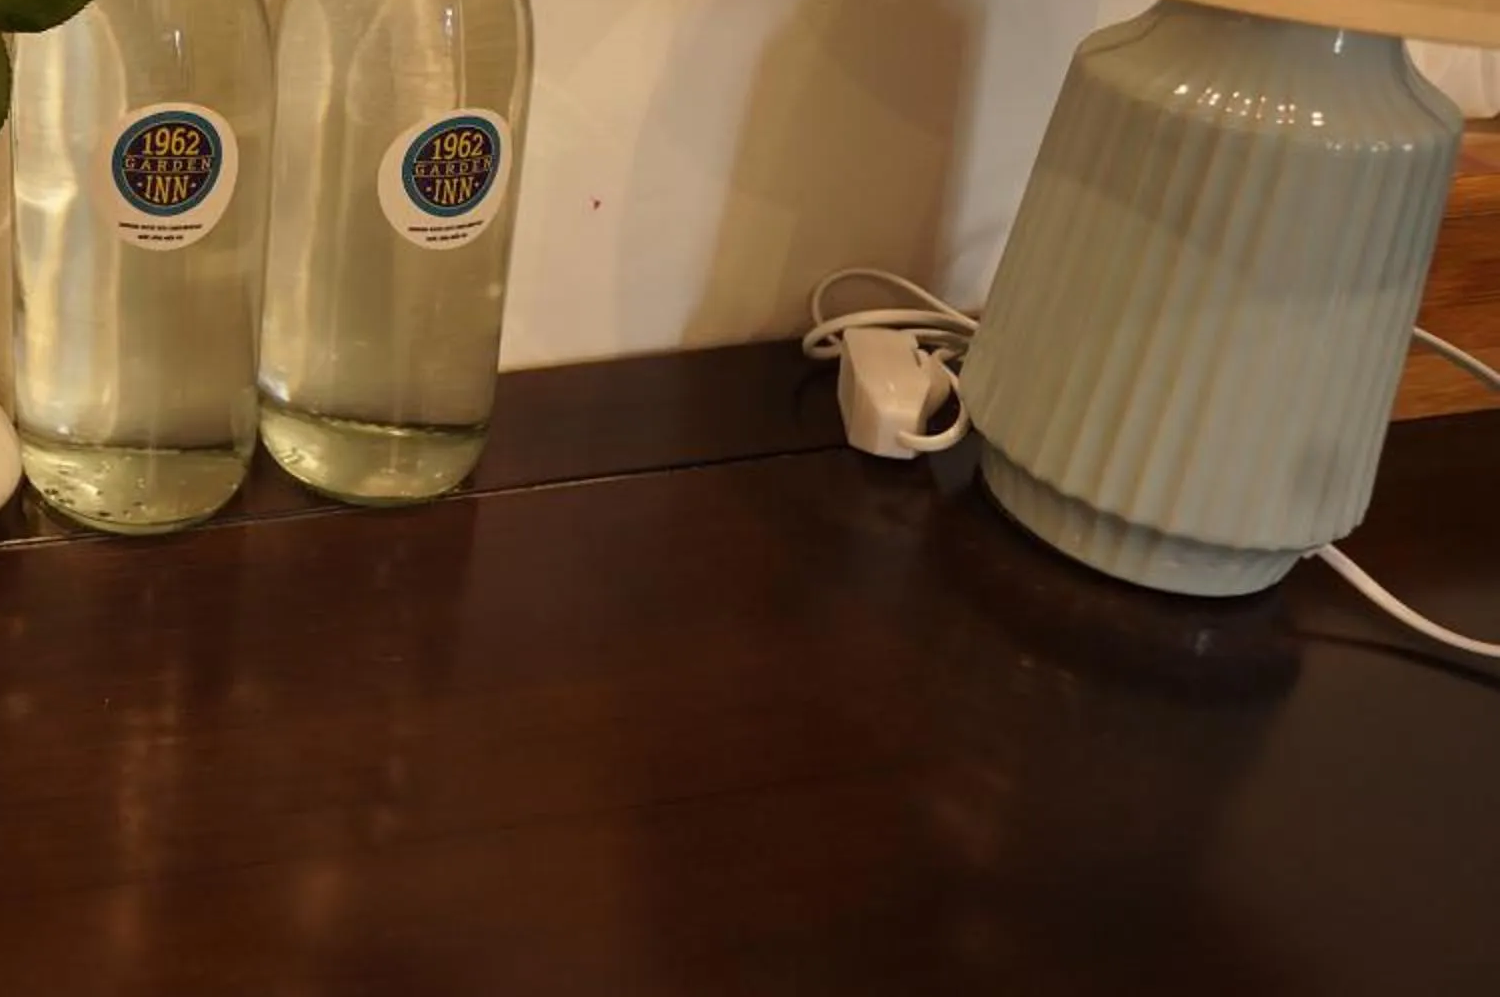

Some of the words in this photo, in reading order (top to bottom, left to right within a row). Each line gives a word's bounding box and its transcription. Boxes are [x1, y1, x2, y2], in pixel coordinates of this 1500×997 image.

[142, 127, 200, 156] 1962
[431, 131, 484, 160] 1962
[125, 157, 211, 172] GARDEN
[415, 155, 492, 177] GARDEN
[145, 174, 189, 203] INN
[434, 176, 474, 204] INN
